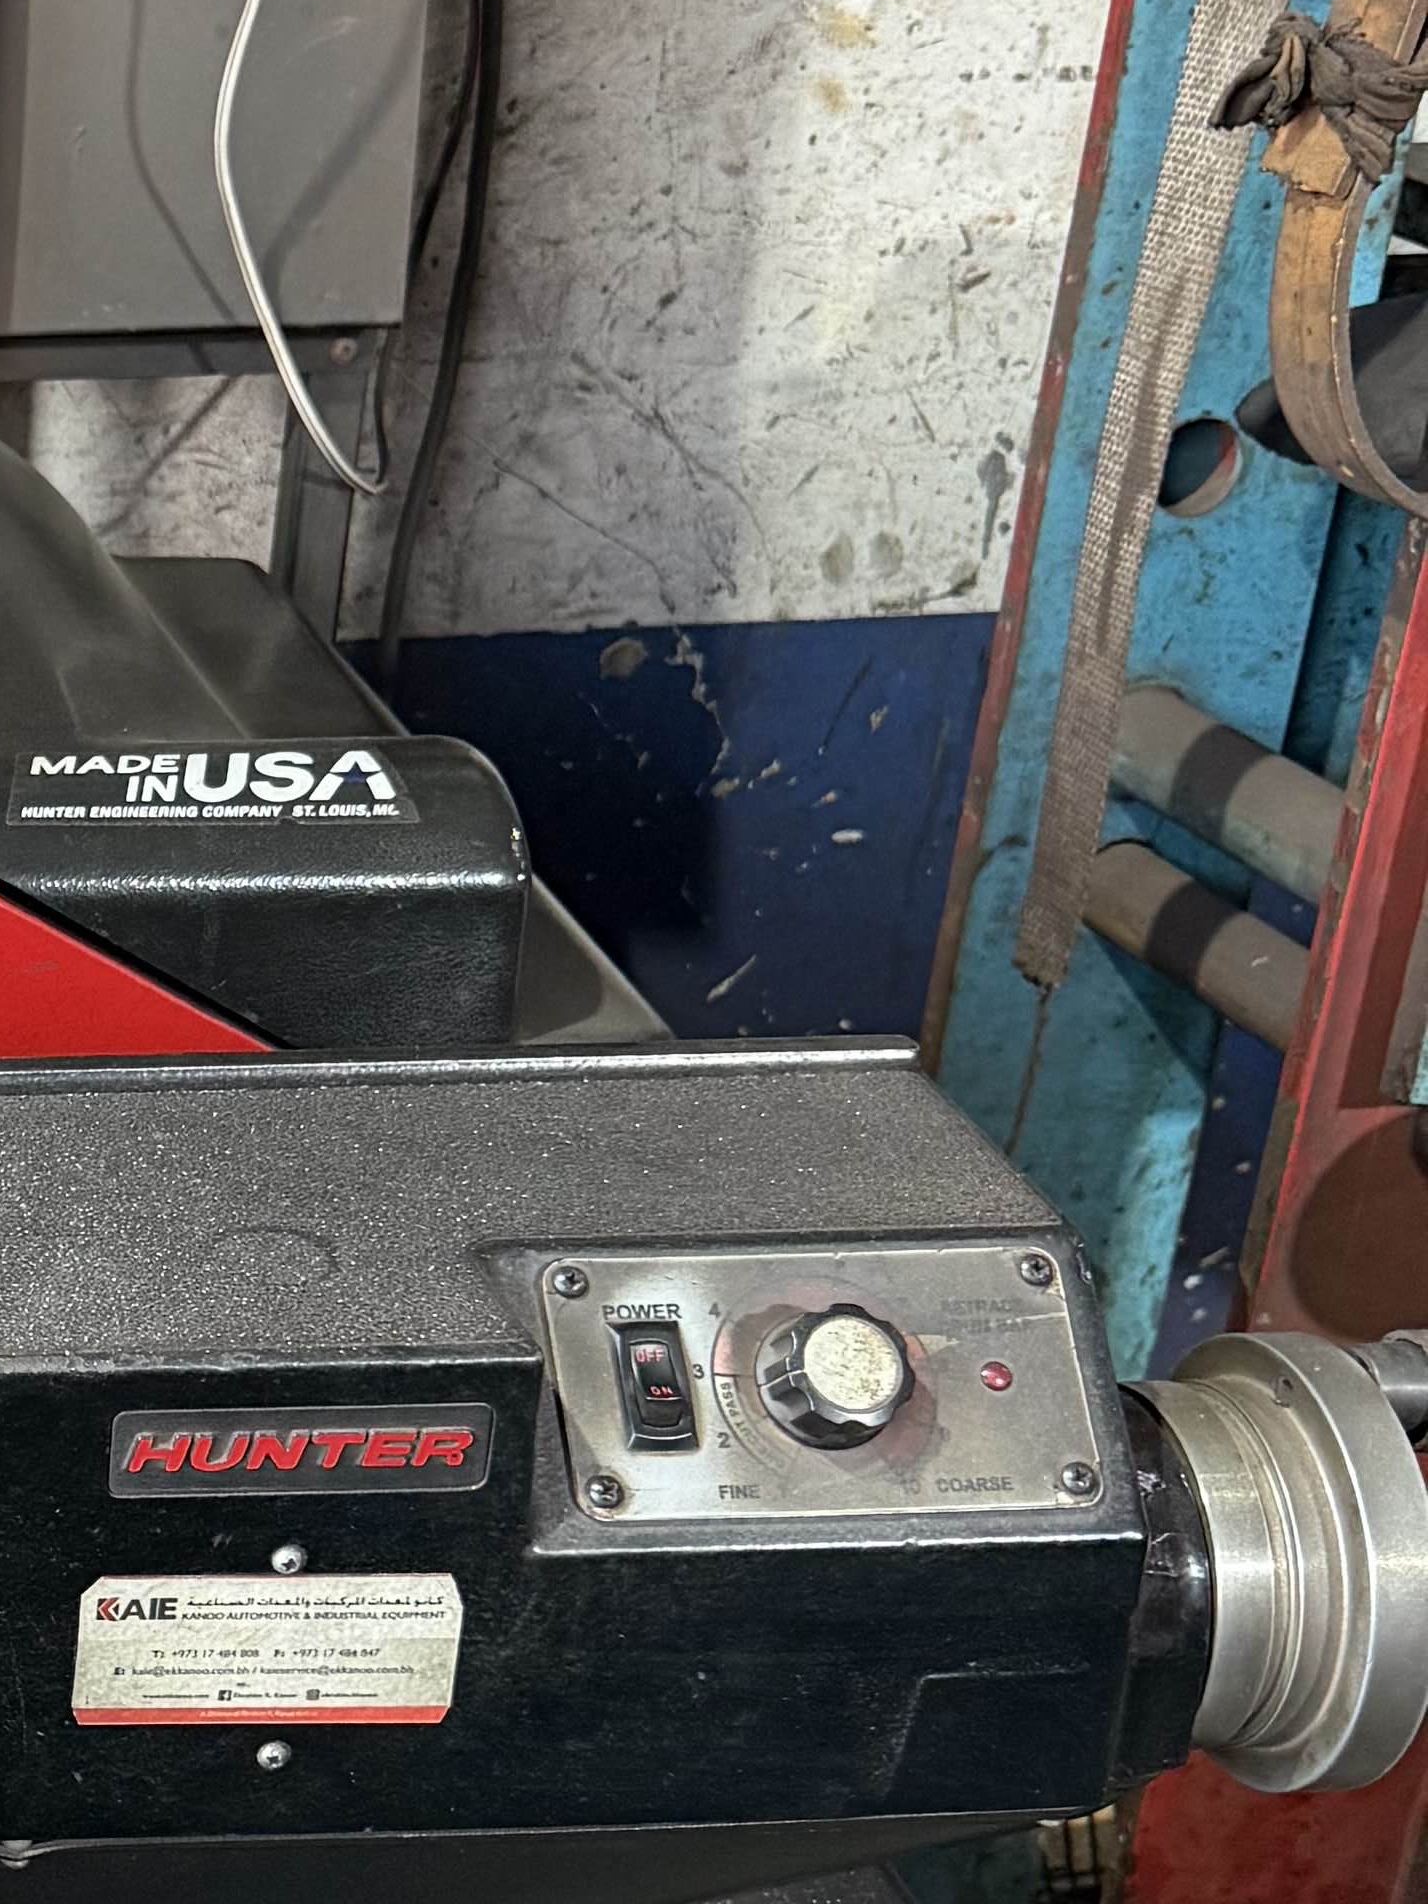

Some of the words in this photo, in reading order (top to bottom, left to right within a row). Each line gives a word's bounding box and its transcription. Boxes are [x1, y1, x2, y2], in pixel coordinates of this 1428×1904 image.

[30, 754, 179, 776] MADE
[125, 775, 177, 803] IN
[183, 750, 398, 804] USA
[21, 804, 86, 819] HUNTER
[89, 804, 198, 819] ENGINEERING
[201, 804, 283, 819] COMPANY
[292, 804, 316, 818] ST.
[601, 1303, 682, 1320] POWER
[708, 1302, 721, 1318] 4
[635, 1348, 665, 1363] OFF
[692, 1363, 705, 1380] 3
[649, 1385, 674, 1396] ON
[717, 1431, 731, 1449] 2
[124, 1429, 474, 1473] HUNTER
[718, 1484, 761, 1500] FINE
[936, 1476, 1014, 1494] COARSE
[96, 1597, 179, 1622] KAIE
[414, 1596, 445, 1608] كانو
[182, 1612, 225, 1621] KANOO
[227, 1611, 301, 1620] AUTOMOTIVE
[303, 1611, 311, 1620] &
[313, 1611, 379, 1620] INDUSTRIAL
[381, 1610, 446, 1619] EQUIPMENT
[202, 1649, 215, 1658] 17
[323, 1648, 335, 1657] 17
